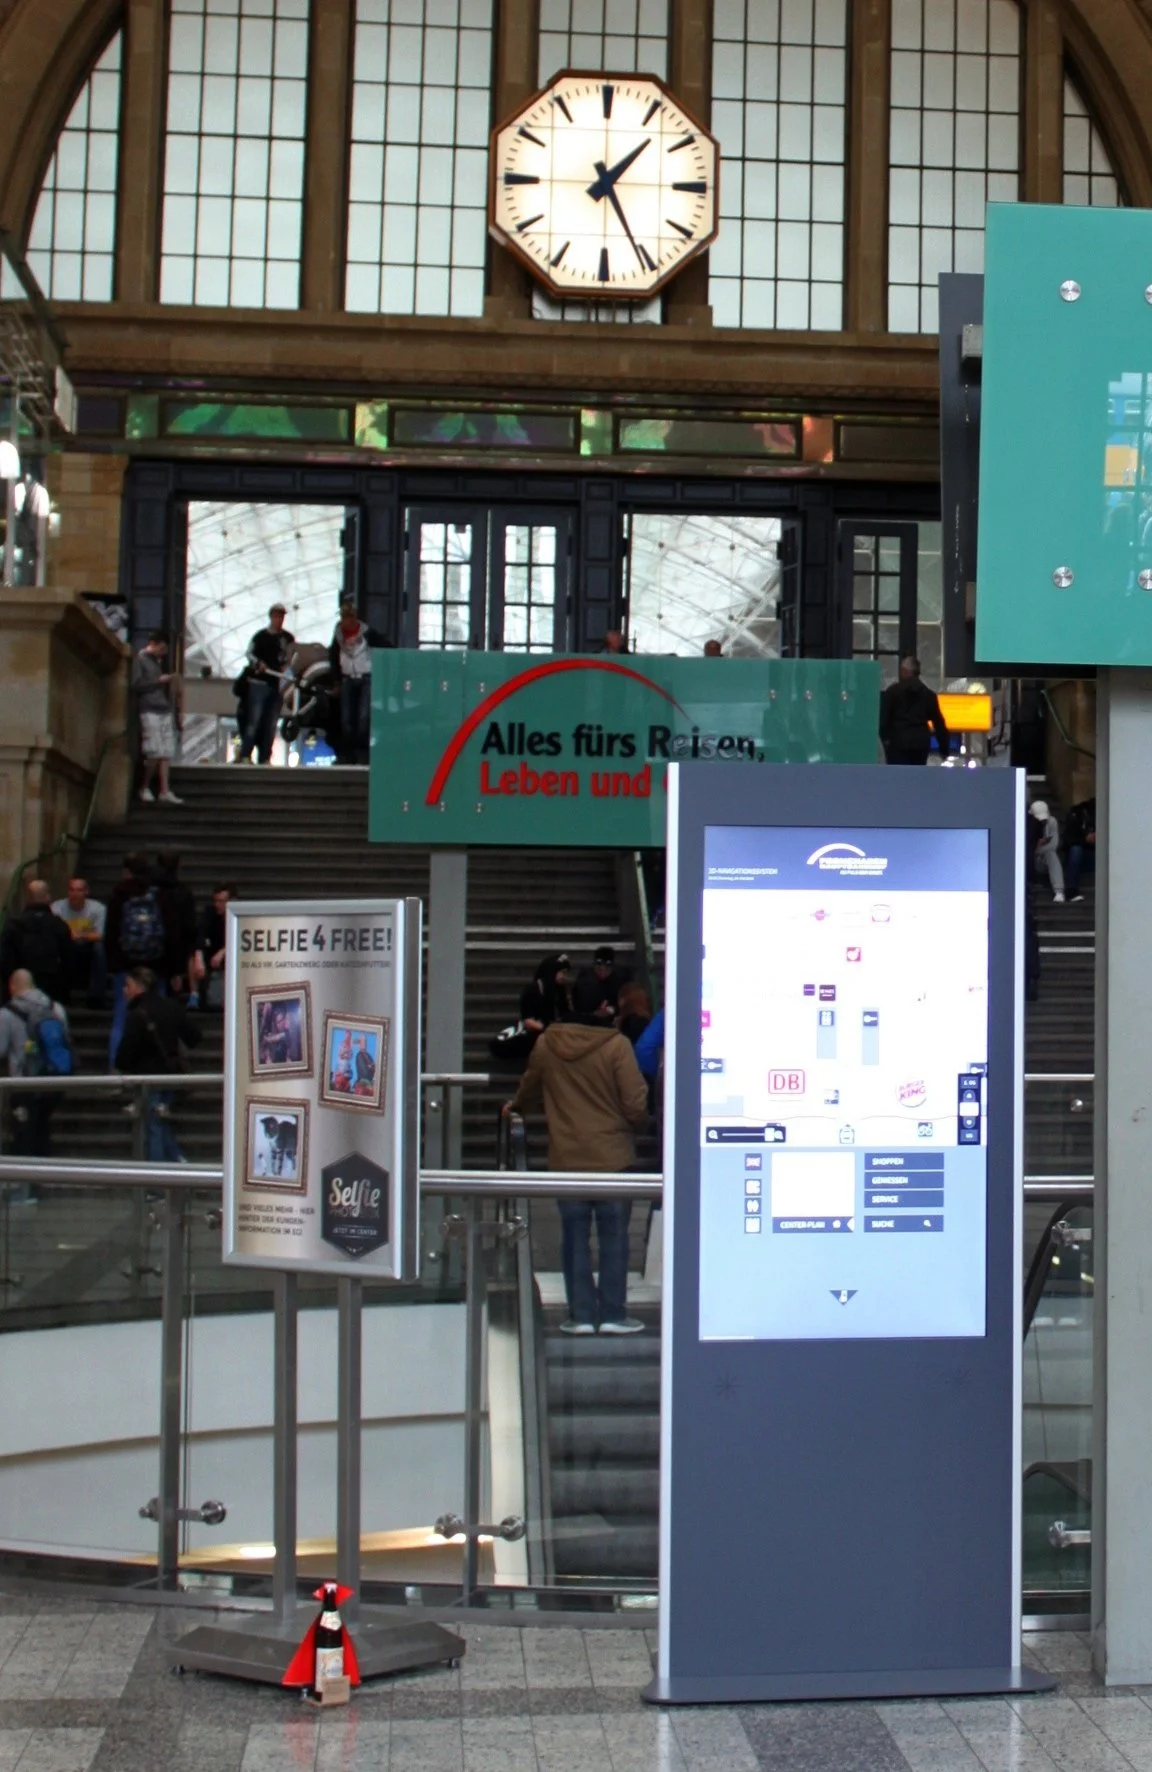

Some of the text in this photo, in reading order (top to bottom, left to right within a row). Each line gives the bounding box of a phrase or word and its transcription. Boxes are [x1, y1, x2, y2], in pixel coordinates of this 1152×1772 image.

[481, 721, 765, 762] Alles fürs Reisen,
[480, 760, 579, 796] Leben
[590, 763, 652, 798] und
[240, 924, 392, 952] SELFIE 4 FREE!
[773, 1073, 800, 1091] DB
[872, 1157, 904, 1166] SHOPPEN
[872, 1176, 908, 1184] GENIESSEN
[329, 1177, 381, 1217] Selfie
[872, 1195, 898, 1203] SERVICE
[872, 1219, 894, 1228] SUCHE
